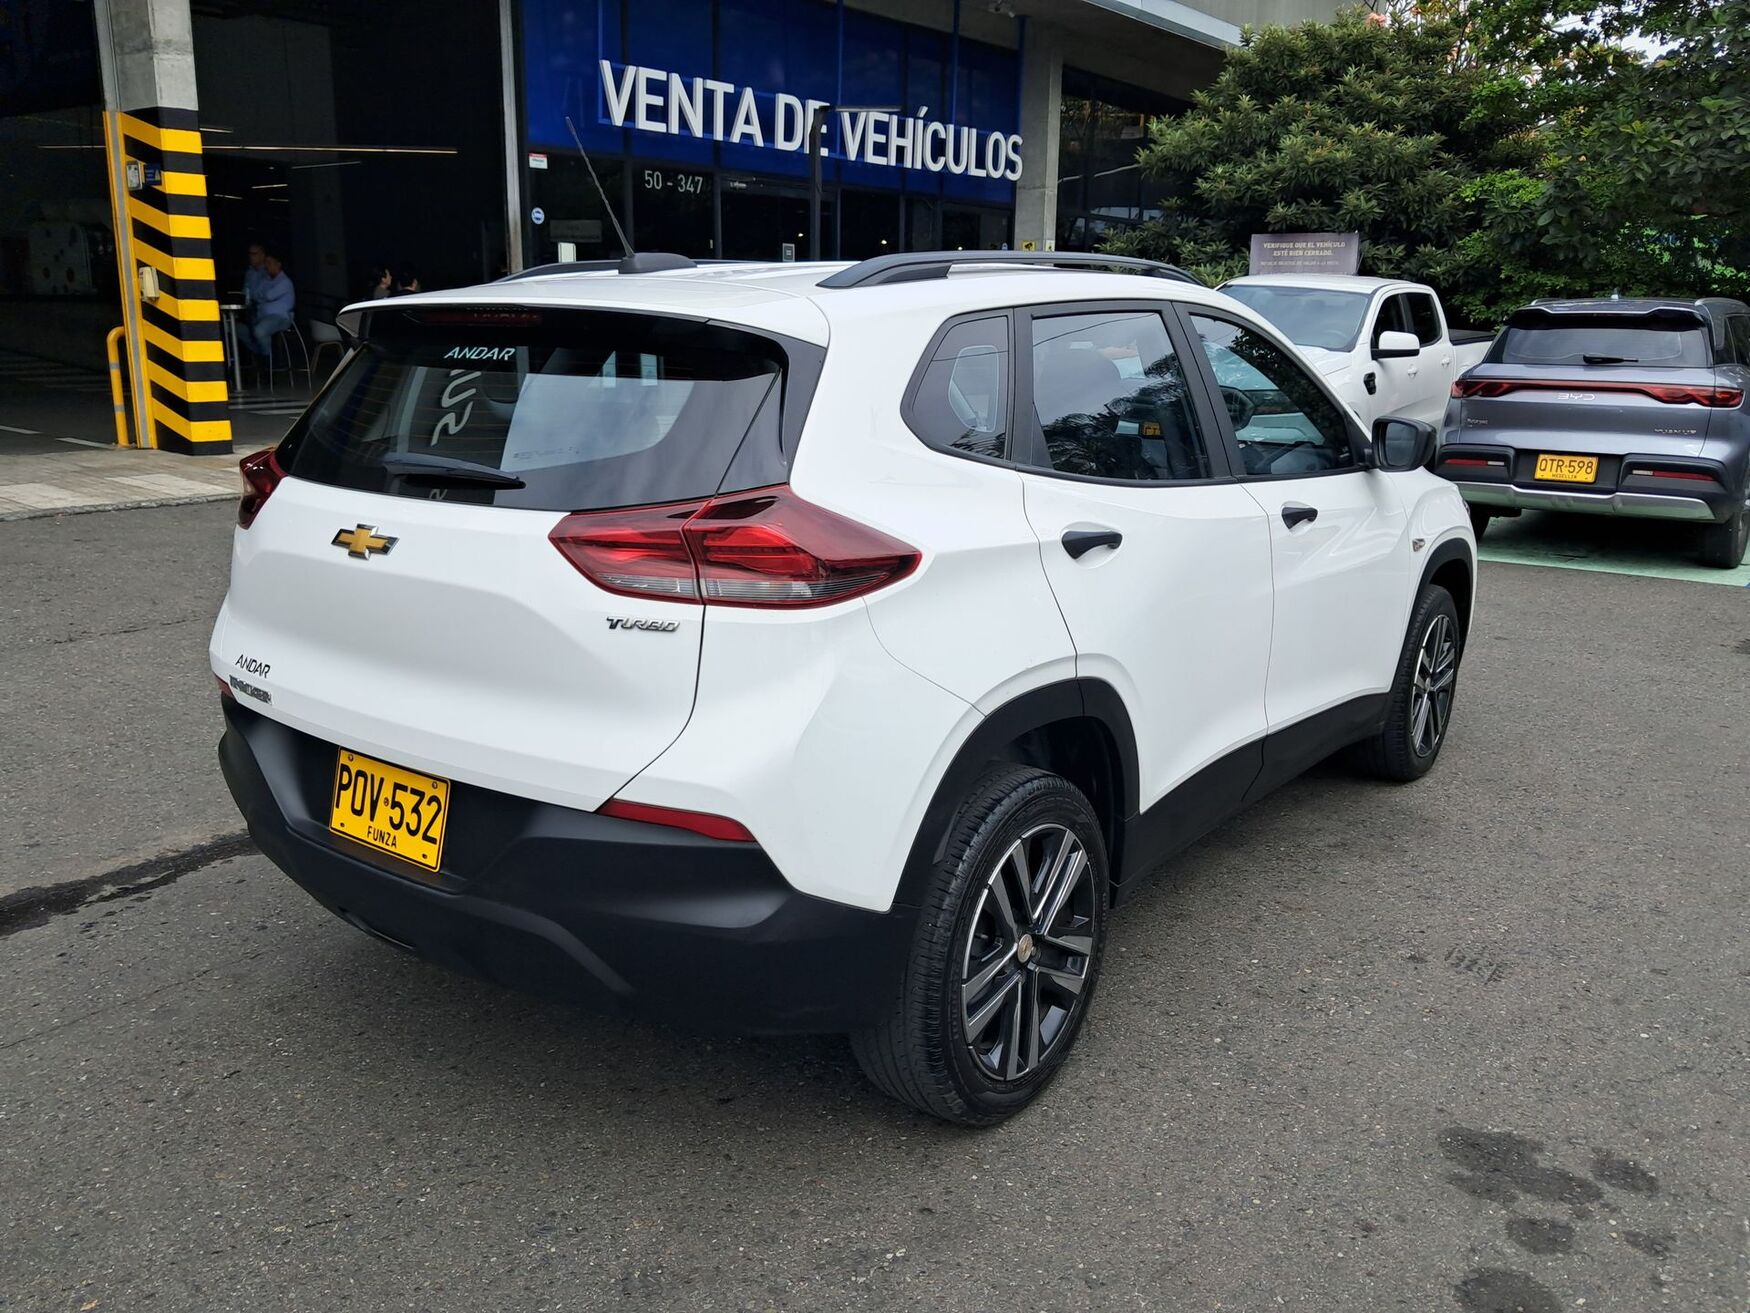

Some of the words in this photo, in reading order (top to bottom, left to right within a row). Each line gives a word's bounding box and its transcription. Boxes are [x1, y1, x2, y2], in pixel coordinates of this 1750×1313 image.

[599, 60, 764, 147] VENTA
[841, 105, 1023, 181] VEHÍCULOS
[644, 169, 662, 190] 50
[677, 173, 704, 194] 347
[444, 346, 516, 361] ANDAR
[606, 616, 681, 633] TURBO
[235, 653, 271, 679] ANDAR
[366, 825, 398, 849] FUNZA
